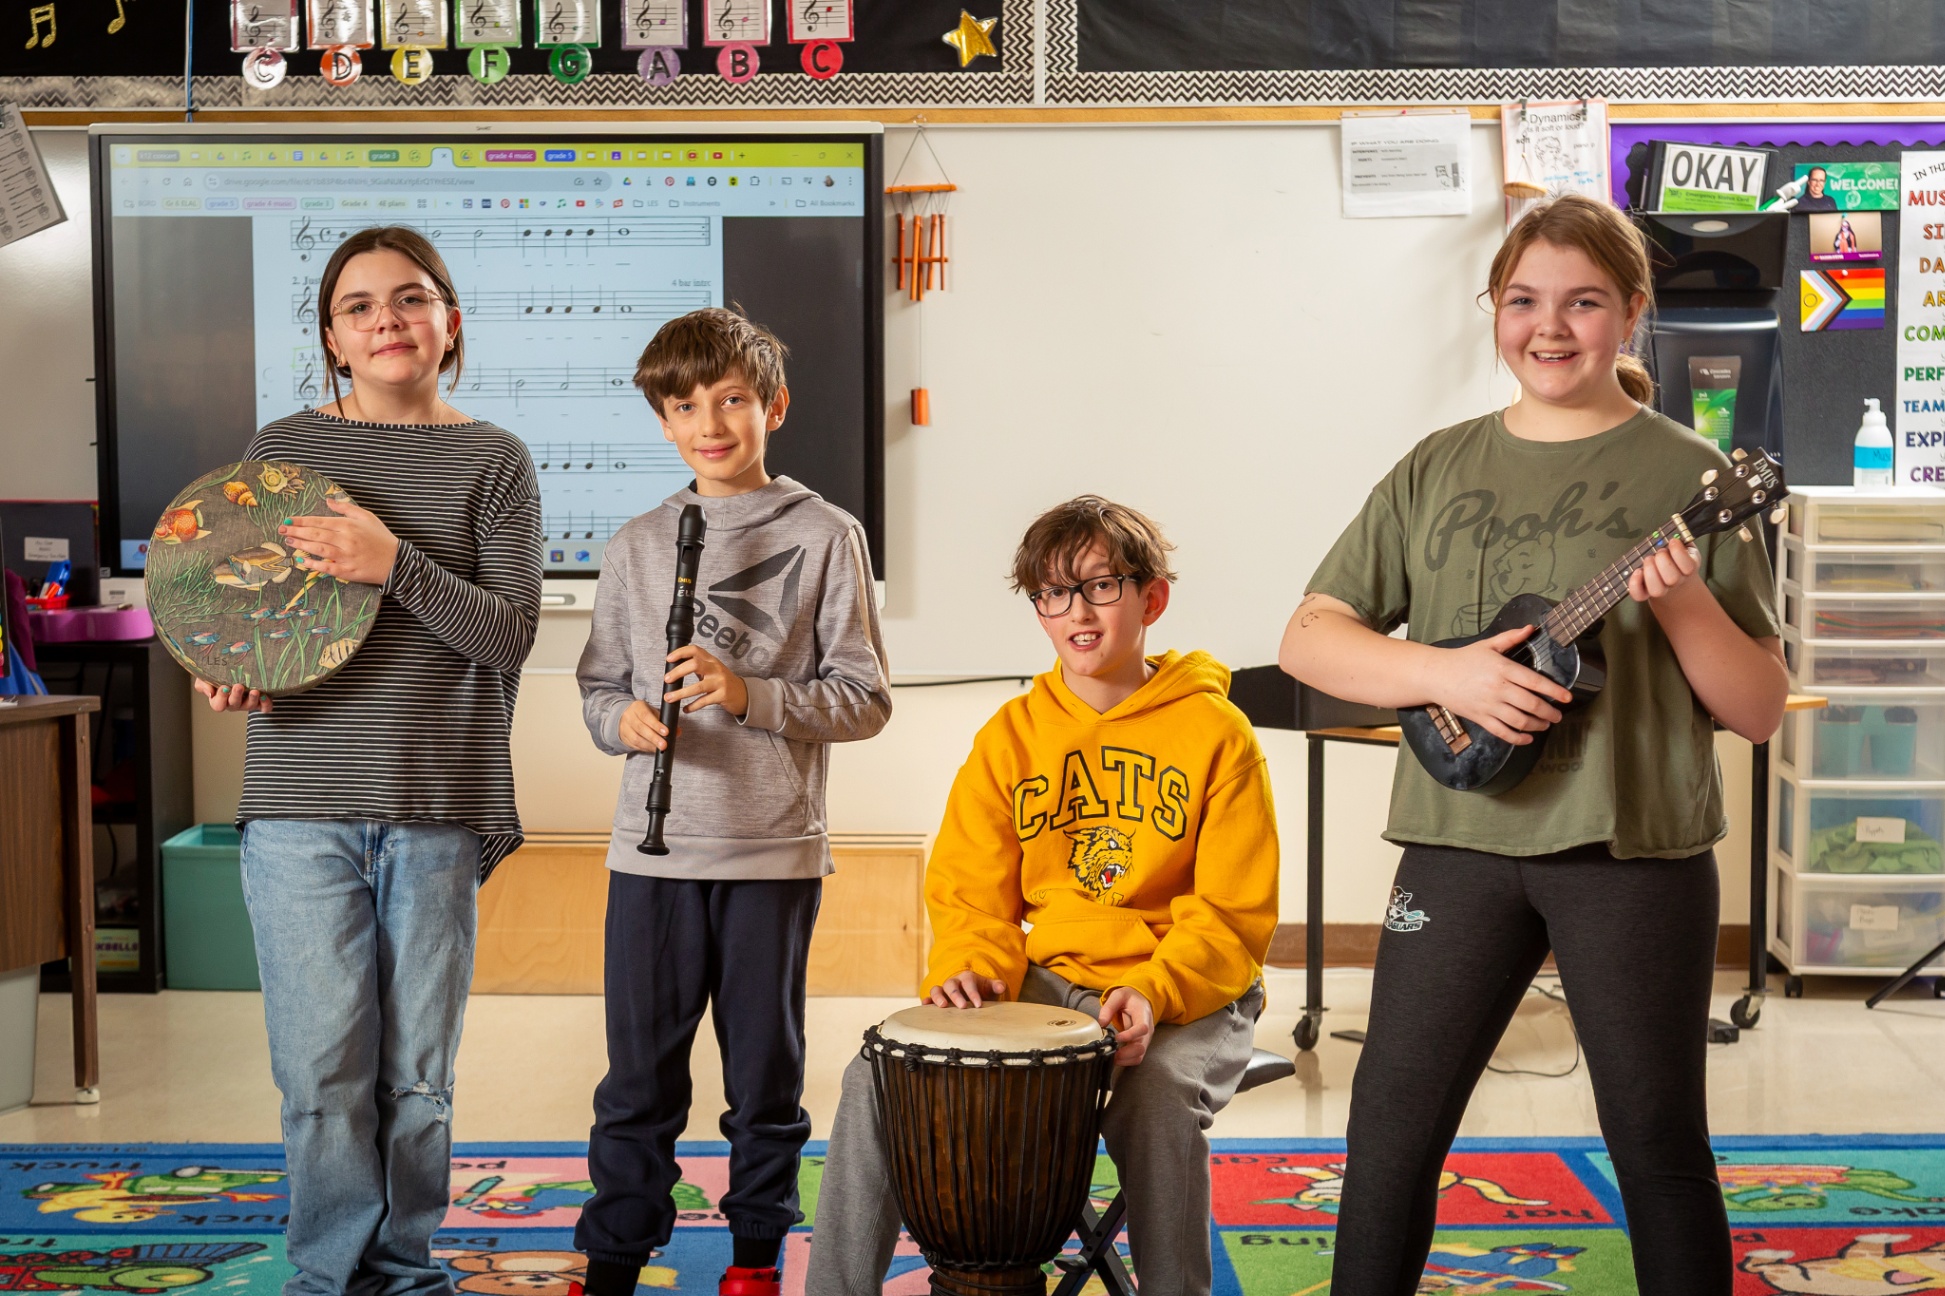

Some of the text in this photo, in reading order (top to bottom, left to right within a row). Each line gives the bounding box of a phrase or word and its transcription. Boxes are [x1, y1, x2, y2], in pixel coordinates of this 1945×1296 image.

[254, 54, 274, 82] C
[332, 52, 350, 79] D
[404, 50, 421, 78] E
[480, 49, 499, 78] F
[559, 49, 580, 76] G
[647, 50, 671, 80] A
[731, 49, 750, 77] B
[811, 44, 831, 72] C
[1529, 112, 1581, 125] Dynamics
[371, 153, 391, 161] grade
[488, 152, 507, 161] grade
[514, 152, 533, 160] music
[547, 152, 567, 161] grade
[1671, 150, 1759, 193] OKAY
[1830, 178, 1899, 191] WELCOME!
[1913, 168, 1928, 181] IN
[1906, 432, 1945, 448] EXP
[1752, 456, 1779, 489] EMUS
[1424, 481, 1642, 572] Pooh's
[693, 597, 770, 669] eebo
[207, 655, 228, 667] LES
[1013, 746, 1190, 842] CATS
[9, 1161, 143, 1173] truck
[1503, 1209, 1595, 1220] hat
[1239, 1233, 1336, 1249] ing
